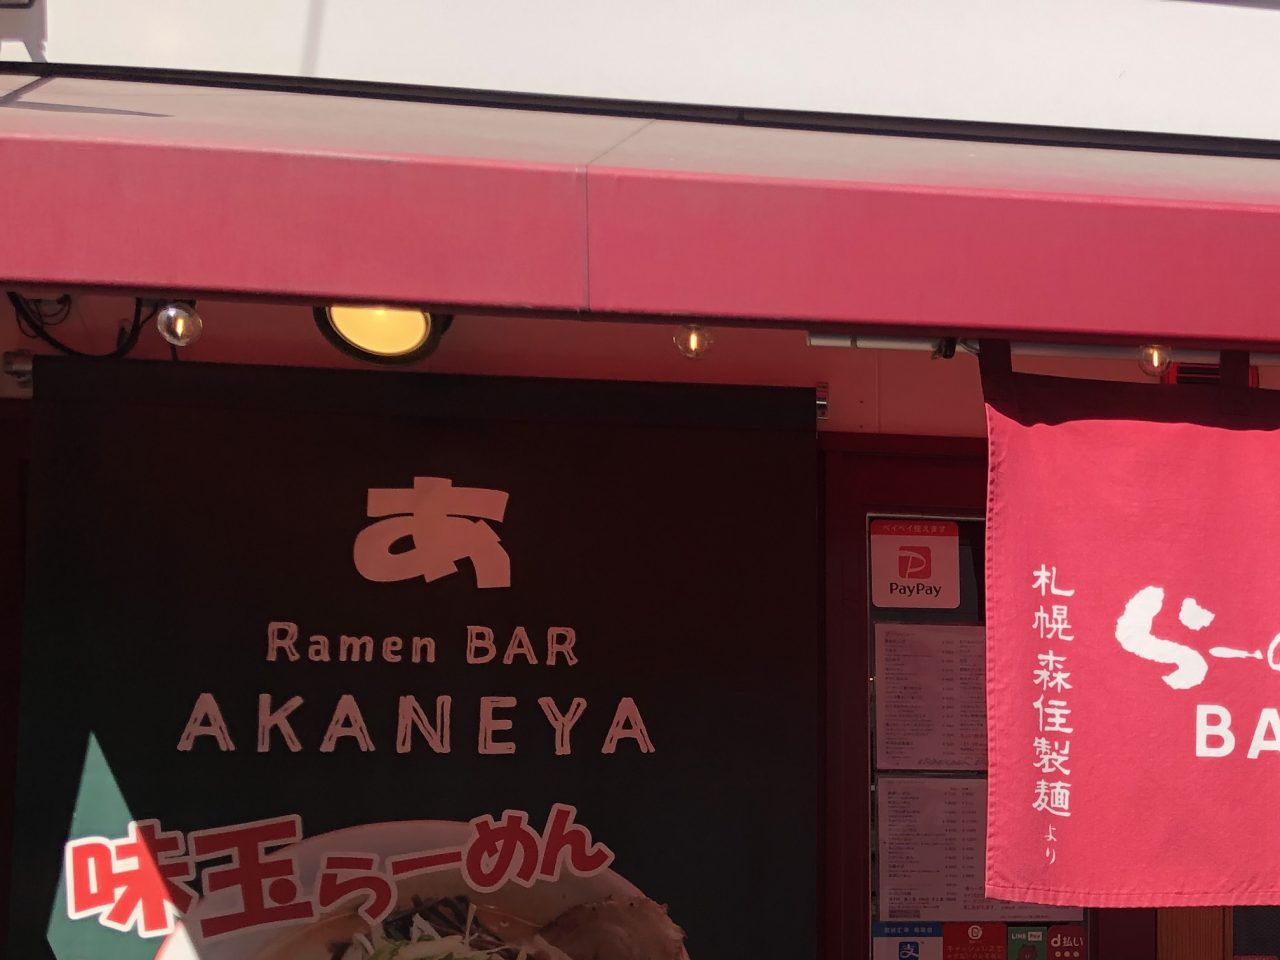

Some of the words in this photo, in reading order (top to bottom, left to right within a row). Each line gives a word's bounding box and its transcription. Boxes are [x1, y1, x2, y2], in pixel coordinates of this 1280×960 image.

[353, 476, 511, 589] あ
[889, 582, 942, 597] PayPay
[266, 621, 437, 664] Ramen
[466, 624, 580, 666] BAR
[177, 692, 657, 756] AKANEYA
[64, 803, 614, 939] 味玉らーめん
[1051, 934, 1084, 948] d払い
